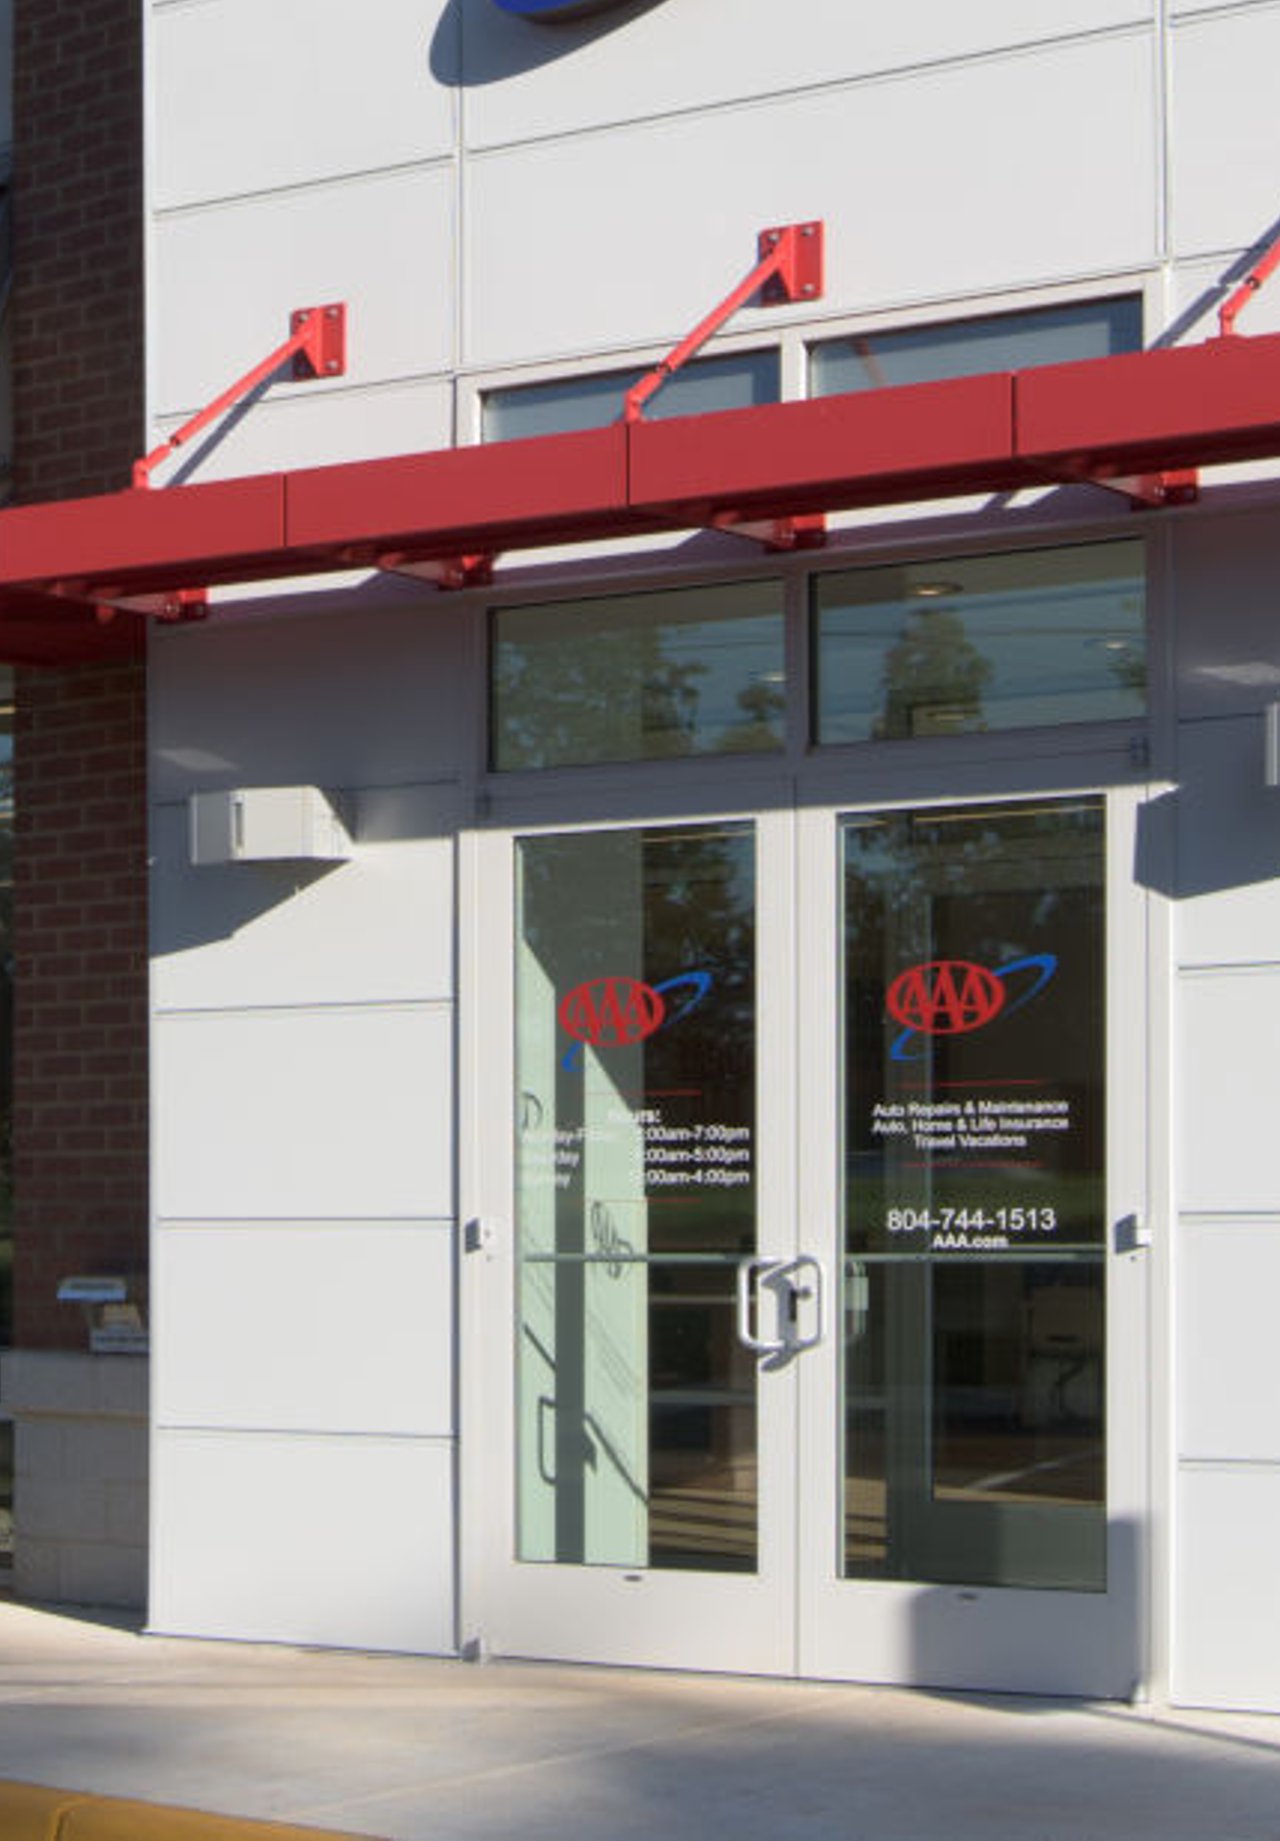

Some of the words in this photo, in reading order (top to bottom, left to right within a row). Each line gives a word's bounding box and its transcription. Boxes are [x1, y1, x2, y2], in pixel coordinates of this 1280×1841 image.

[892, 962, 999, 1033] AAA
[564, 978, 660, 1046] AAA
[873, 1102, 905, 1117] Auto
[908, 1102, 961, 1119] Repairs
[964, 1101, 974, 1115] &
[977, 1100, 1068, 1114] Maintenance
[873, 1119, 907, 1134] Auto,
[912, 1119, 952, 1133] Home
[956, 1118, 967, 1132] &
[971, 1117, 997, 1132] Life
[999, 1117, 1068, 1131] Insurance
[916, 1135, 956, 1148] Travel
[958, 1135, 1027, 1148] Vacations
[887, 1207, 1057, 1231] 804-744-1513
[932, 1233, 1010, 1249] AAA.com
